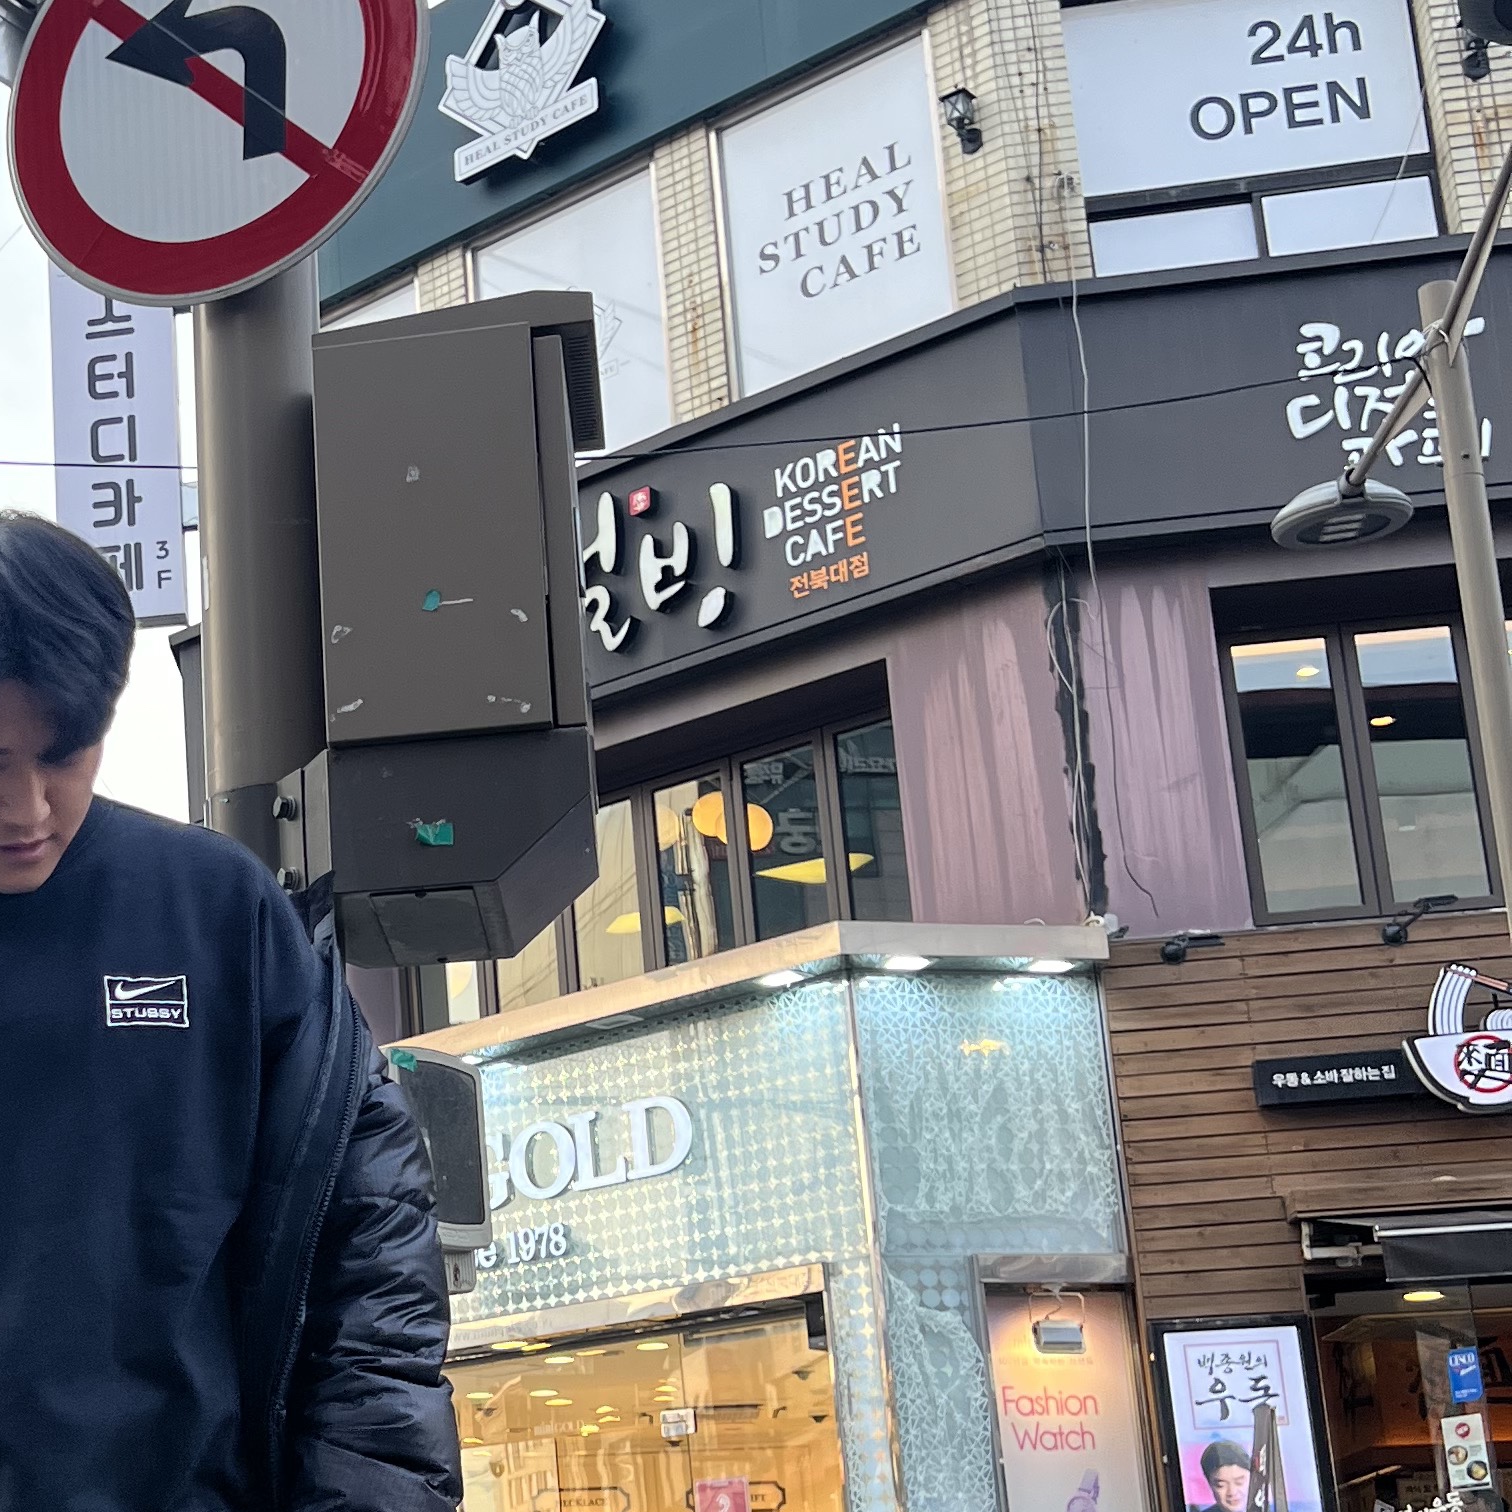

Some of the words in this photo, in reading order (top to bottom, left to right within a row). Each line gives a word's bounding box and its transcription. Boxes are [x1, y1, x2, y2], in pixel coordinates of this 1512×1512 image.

[1248, 12, 1362, 66] 24h
[464, 140, 501, 167] HEAL
[504, 114, 549, 146] STUDY
[552, 93, 588, 120] CAFE
[1190, 77, 1371, 140] OPEN
[782, 141, 911, 221] HEAL
[759, 179, 914, 275] STUDY
[801, 224, 921, 298] CAFE
[774, 423, 903, 498] KOREAN
[763, 461, 901, 539] DESSERT
[785, 512, 867, 567] CAFE
[789, 552, 870, 599] 전북대점
[506, 1222, 567, 1265] 1978
[1001, 1386, 1099, 1417] Fashion
[1011, 1421, 1096, 1451] Watch
